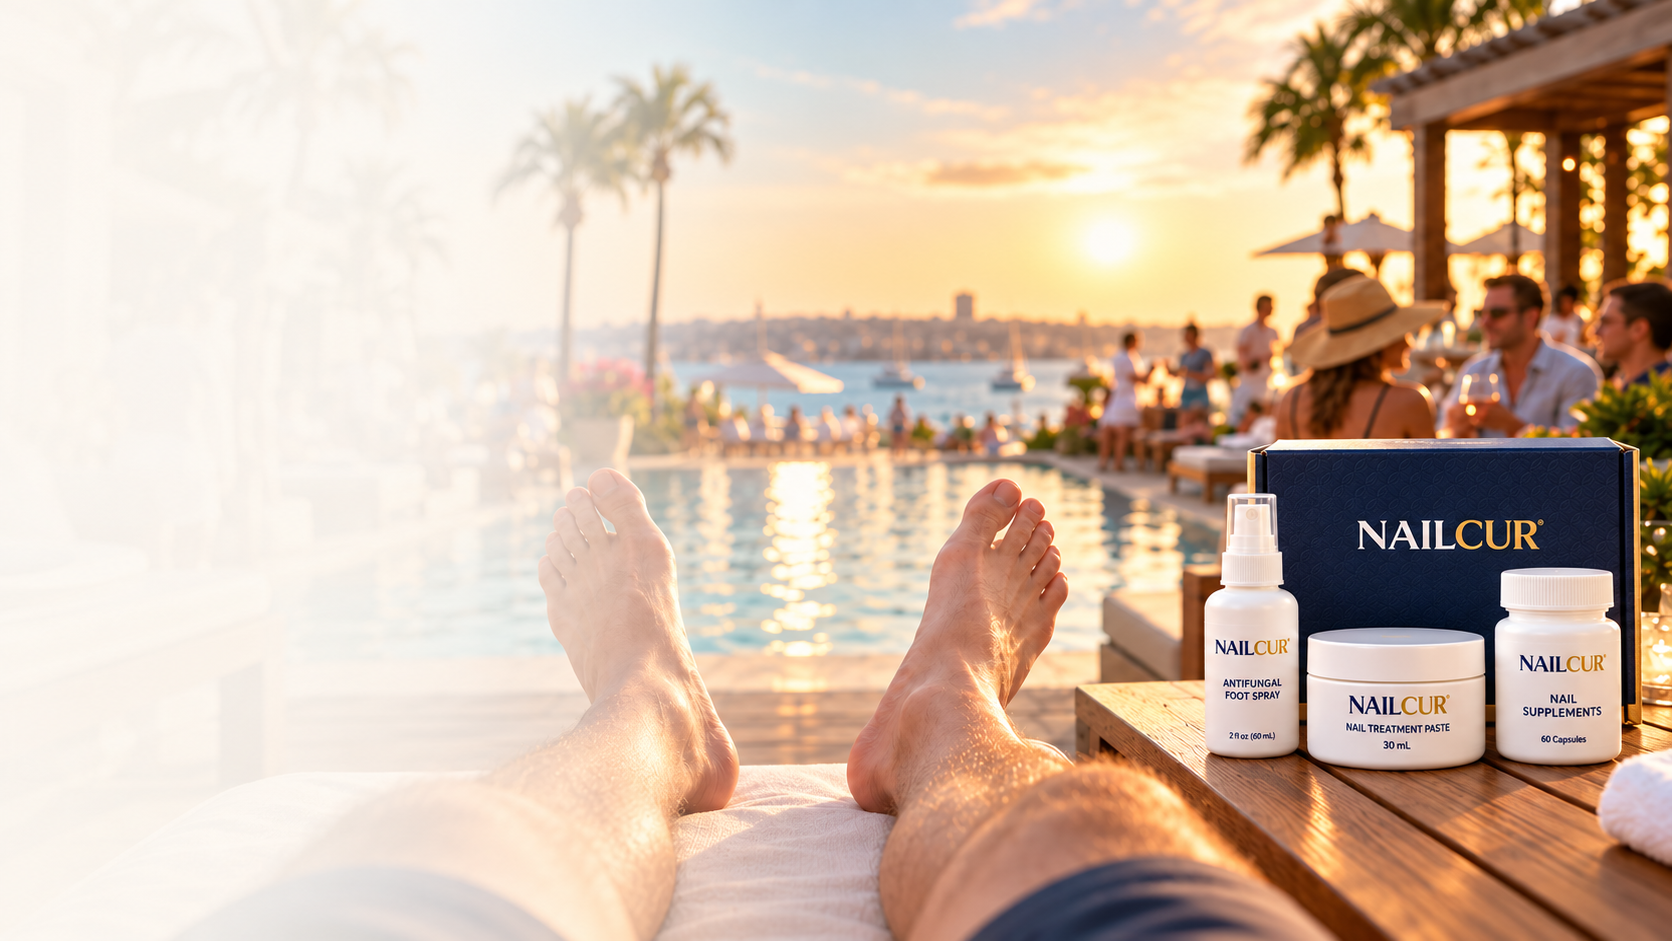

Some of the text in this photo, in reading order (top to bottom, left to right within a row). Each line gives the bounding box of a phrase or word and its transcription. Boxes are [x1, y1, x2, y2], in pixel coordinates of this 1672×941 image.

[1223, 678, 1283, 688] ANTIFUNGAL
[1225, 690, 1281, 701] FOOT SPRAY
[1550, 693, 1578, 704] NAIL
[1522, 705, 1602, 718] SUPPLEMENTS
[1345, 722, 1451, 734] NAIL TREATMENT PASTE
[1229, 731, 1234, 740] 2
[1234, 732, 1240, 740] fl
[1250, 732, 1262, 741] (60
[1262, 731, 1276, 741] mL)
[1540, 734, 1587, 746] 60 Capsules
[1383, 740, 1412, 750] 30 mL
